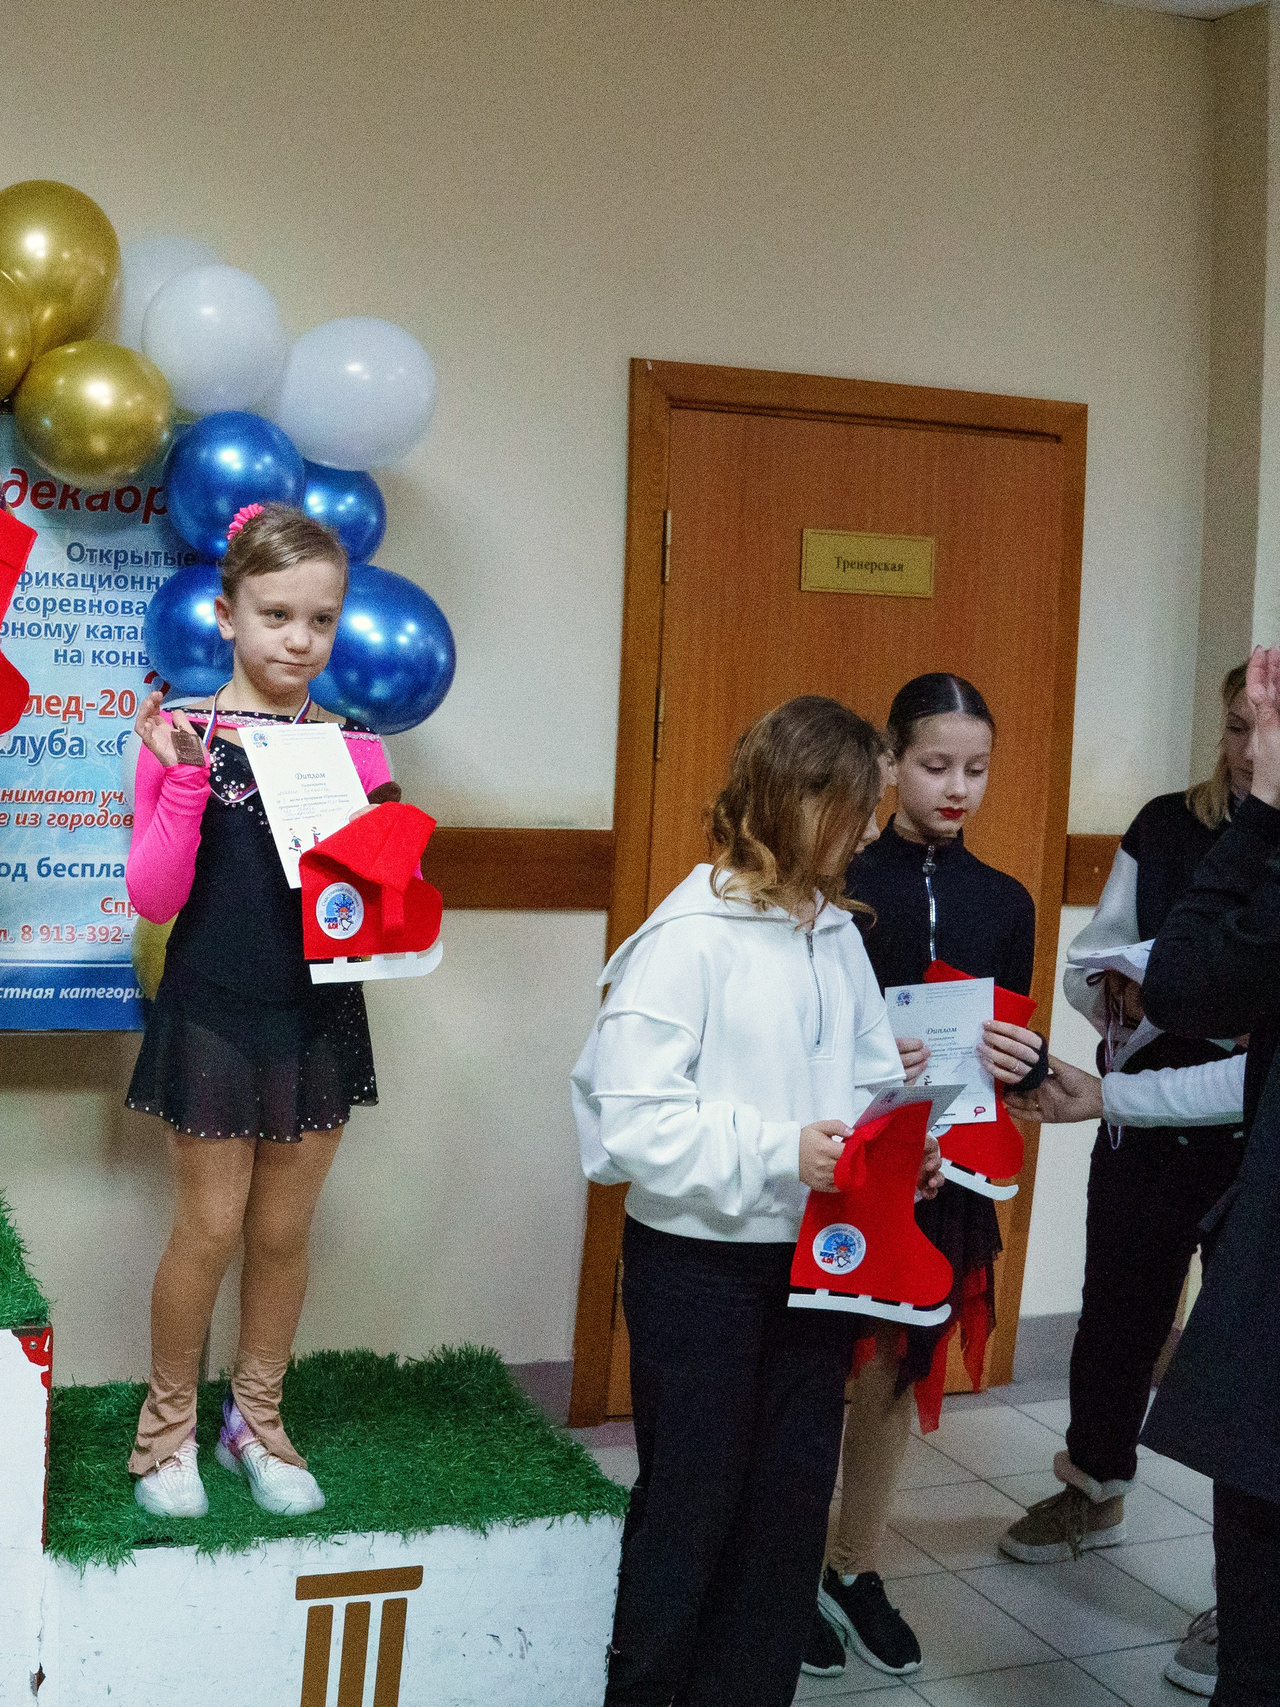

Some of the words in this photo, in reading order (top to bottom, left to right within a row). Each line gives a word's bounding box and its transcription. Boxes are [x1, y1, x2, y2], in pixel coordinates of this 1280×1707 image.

[66, 542, 198, 569] Открытые
[834, 556, 905, 574] Тренерская
[17, 571, 168, 592] фикационн
[13, 596, 148, 618] соревнова
[86, 624, 144, 641] ката
[54, 649, 83, 665] на
[294, 772, 326, 780] Диплом
[99, 790, 128, 807] уч
[15, 813, 40, 826] из
[46, 810, 134, 831] городов
[37, 857, 125, 878] беспла
[21, 925, 32, 941] 8
